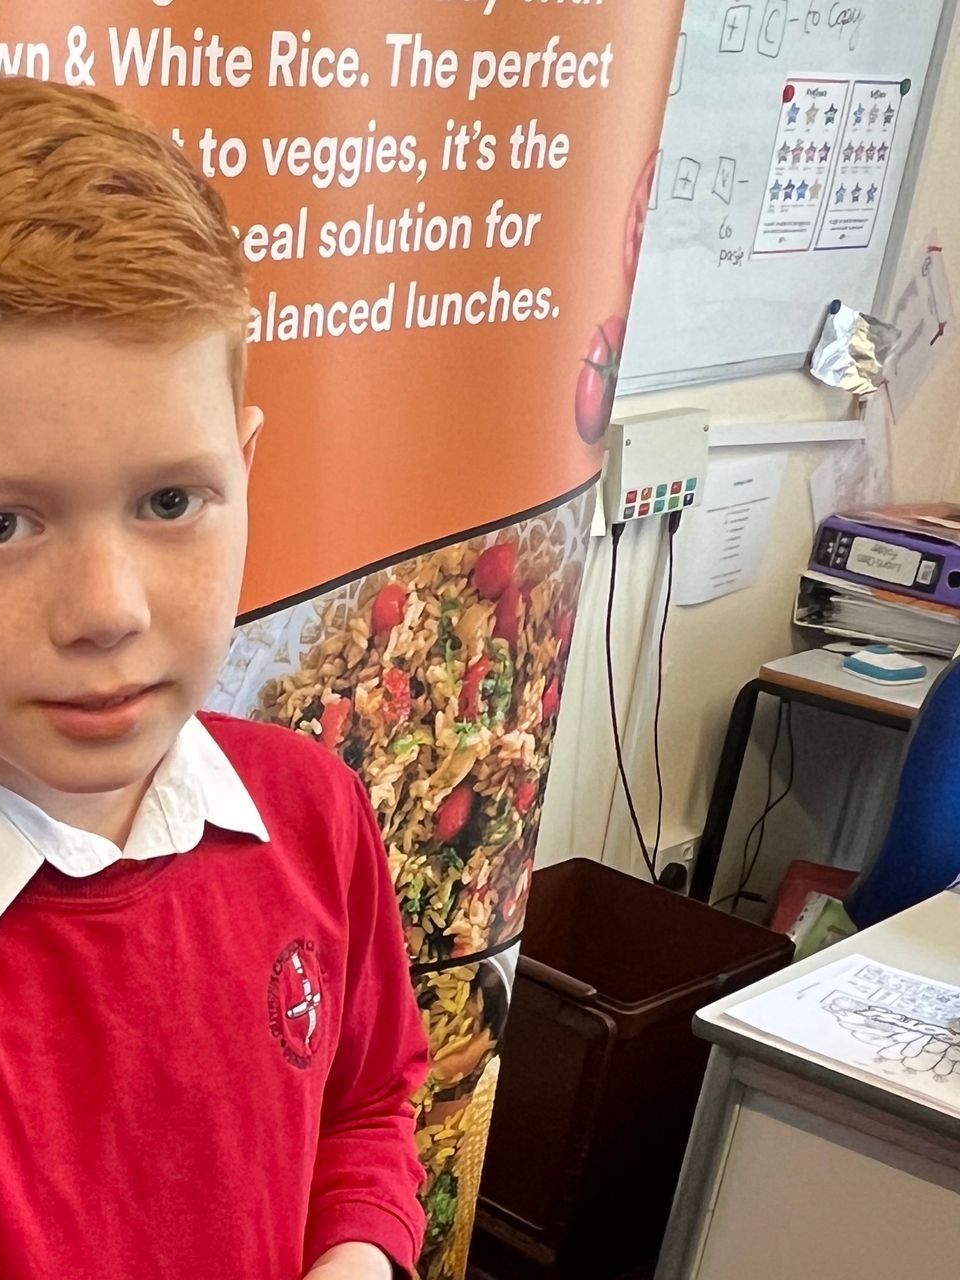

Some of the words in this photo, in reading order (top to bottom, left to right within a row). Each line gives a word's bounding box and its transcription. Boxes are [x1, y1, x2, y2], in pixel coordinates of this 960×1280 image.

[64, 25, 95, 87] &
[108, 27, 253, 88] White
[268, 29, 369, 88] Rice.
[385, 33, 458, 88] The
[469, 35, 614, 100] perfect
[200, 127, 247, 177] to
[262, 120, 428, 189] veggies,
[441, 119, 497, 172] it's
[509, 119, 570, 170] the
[231, 207, 308, 263] eal
[319, 204, 472, 258] solution
[485, 199, 542, 249] for
[404, 276, 560, 329] lunches.
